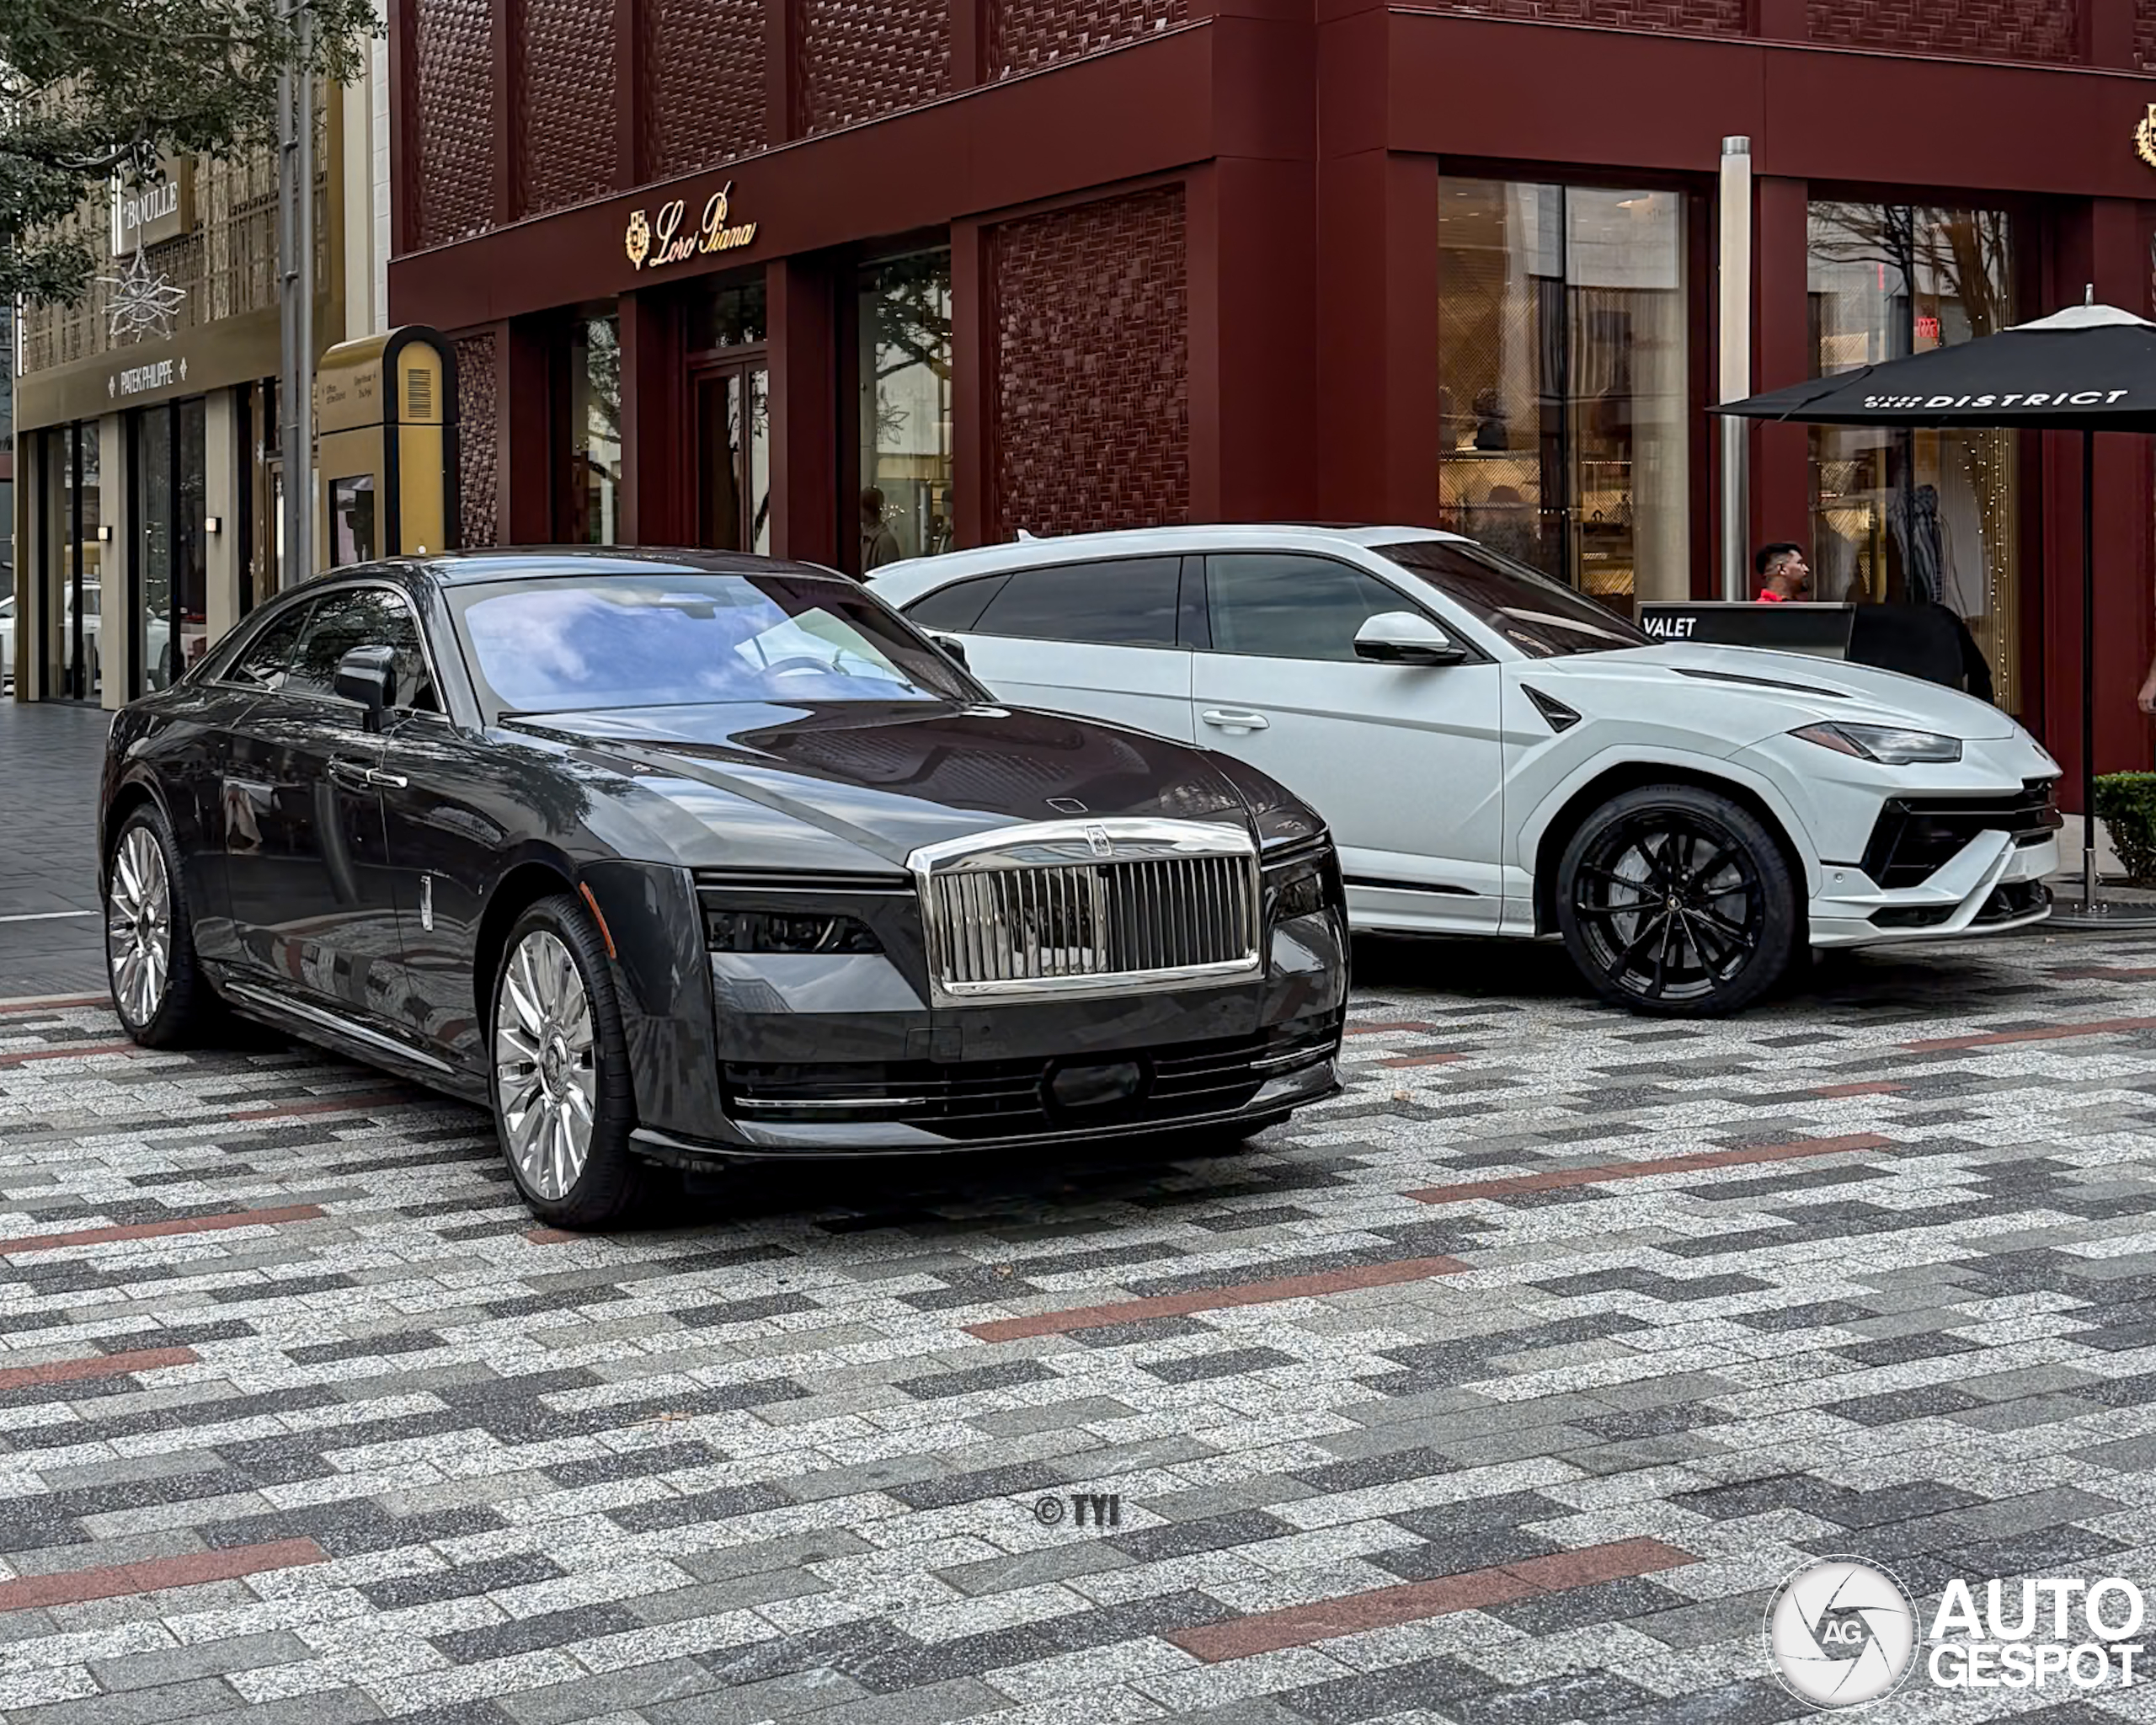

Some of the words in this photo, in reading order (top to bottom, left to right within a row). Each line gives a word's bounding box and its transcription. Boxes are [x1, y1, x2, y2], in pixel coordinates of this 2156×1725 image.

[126, 181, 178, 229] BOULLE
[648, 200, 699, 267] Loro
[698, 180, 757, 254] Piana
[120, 367, 142, 396] PATEK
[142, 359, 173, 390] PHILIPPE
[1924, 390, 2128, 408] DISTRICT
[1643, 617, 1696, 637] VALET
